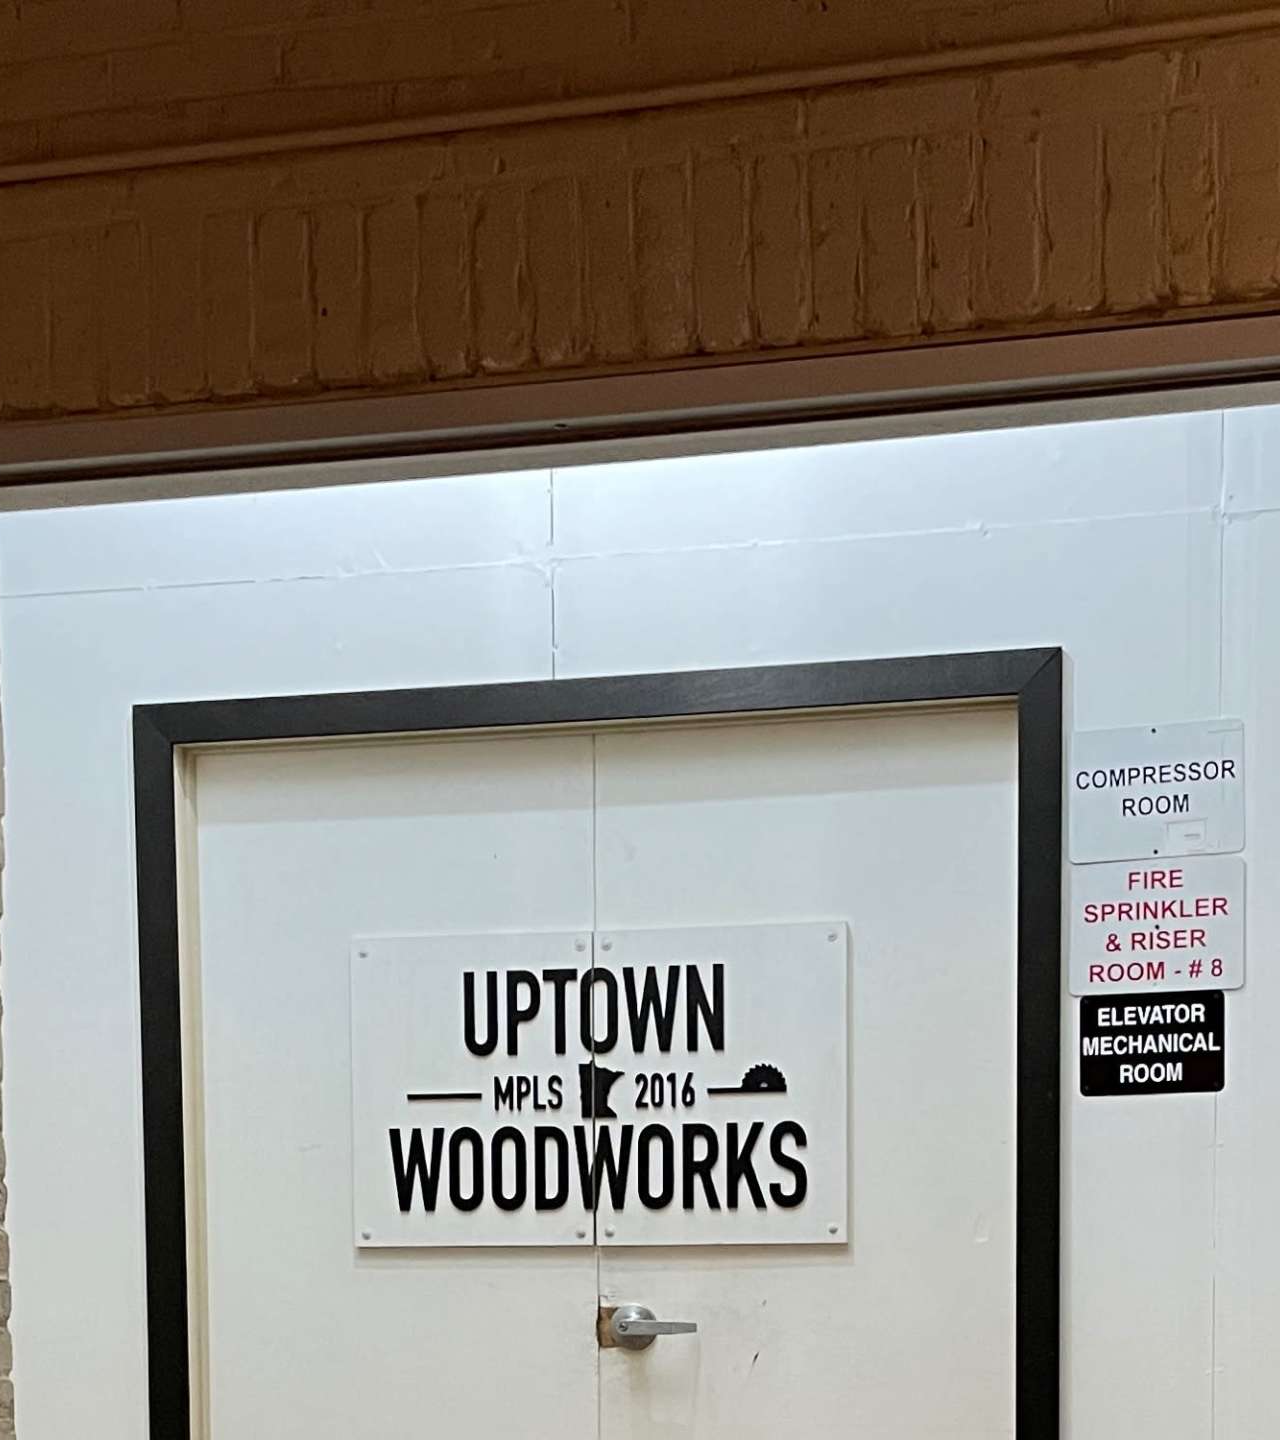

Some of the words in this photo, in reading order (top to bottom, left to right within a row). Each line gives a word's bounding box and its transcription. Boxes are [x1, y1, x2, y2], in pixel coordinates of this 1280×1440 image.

[1075, 759, 1237, 790] COMPRESSOR
[1121, 794, 1190, 817] ROOM
[1127, 869, 1184, 891] FIRE
[1083, 897, 1229, 923] SPRINKLER
[1105, 933, 1122, 953] &
[1130, 929, 1207, 951] RISER
[1088, 960, 1166, 983] ROOM
[1188, 959, 1204, 978] #
[1210, 958, 1224, 978] 8
[463, 963, 725, 1058] UPTOWN
[1097, 1003, 1206, 1027] ELEVATOR
[1081, 1032, 1221, 1057] MECHANICAL
[1119, 1062, 1184, 1084] ROOM
[493, 1074, 563, 1112] MPLS
[634, 1071, 696, 1110] 2016
[388, 1120, 808, 1213] WOODWORKS
